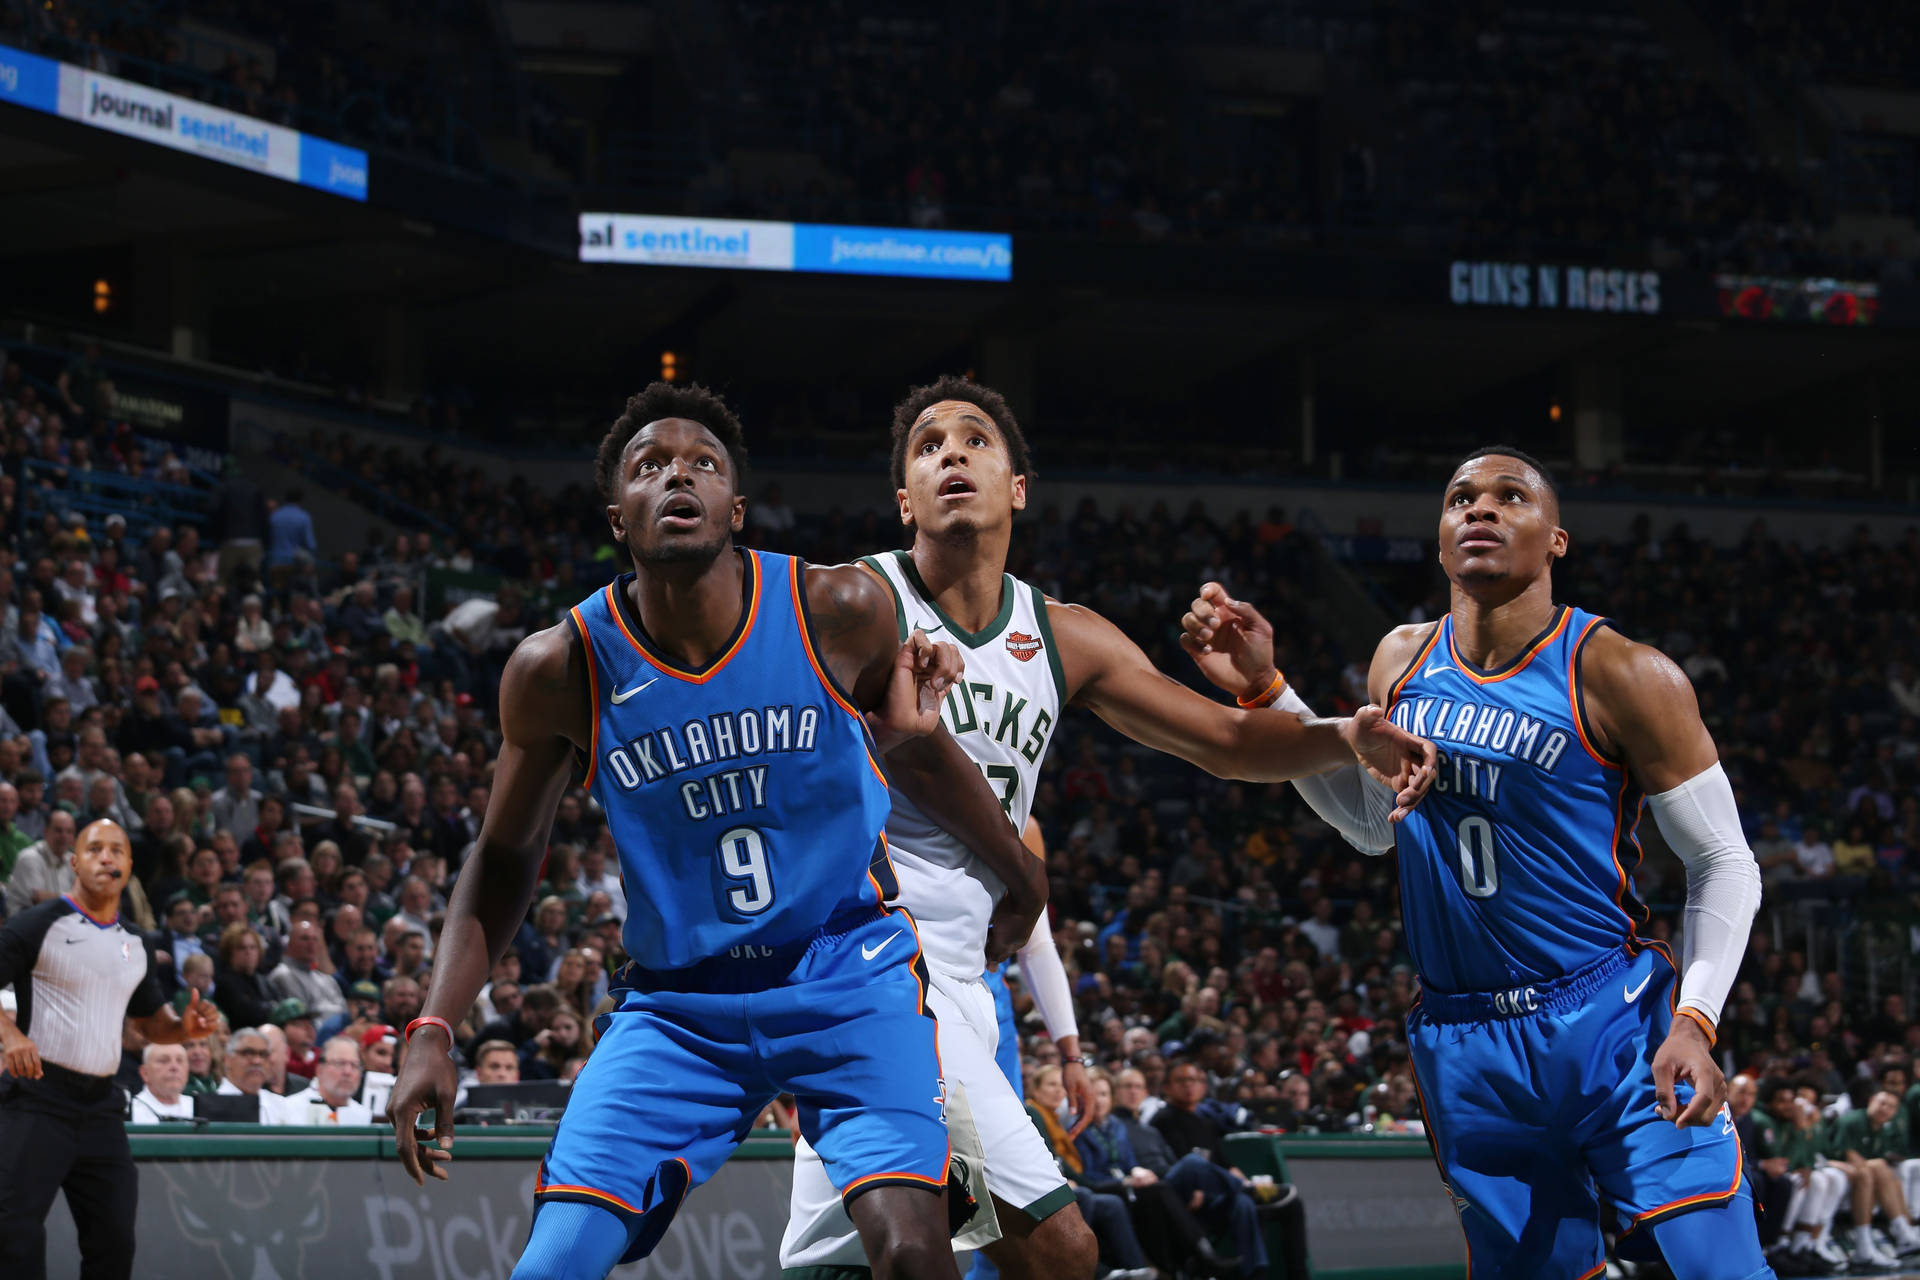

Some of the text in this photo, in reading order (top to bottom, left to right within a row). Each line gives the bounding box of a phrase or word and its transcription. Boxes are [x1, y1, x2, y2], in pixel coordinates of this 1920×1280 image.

[90, 82, 173, 128] journal
[180, 116, 268, 160] sentinel
[626, 229, 749, 253] sentinel
[1450, 261, 1660, 314] GUNS N ROSES
[607, 706, 822, 792] OKLAHOMA
[1395, 697, 1570, 774] OKLAHOMA
[680, 765, 769, 821] CITY
[1434, 750, 1504, 804] CITY
[717, 825, 775, 916] 9
[1457, 814, 1500, 898] 0
[1495, 987, 1538, 1014] OKC
[363, 1194, 520, 1280] Pick
